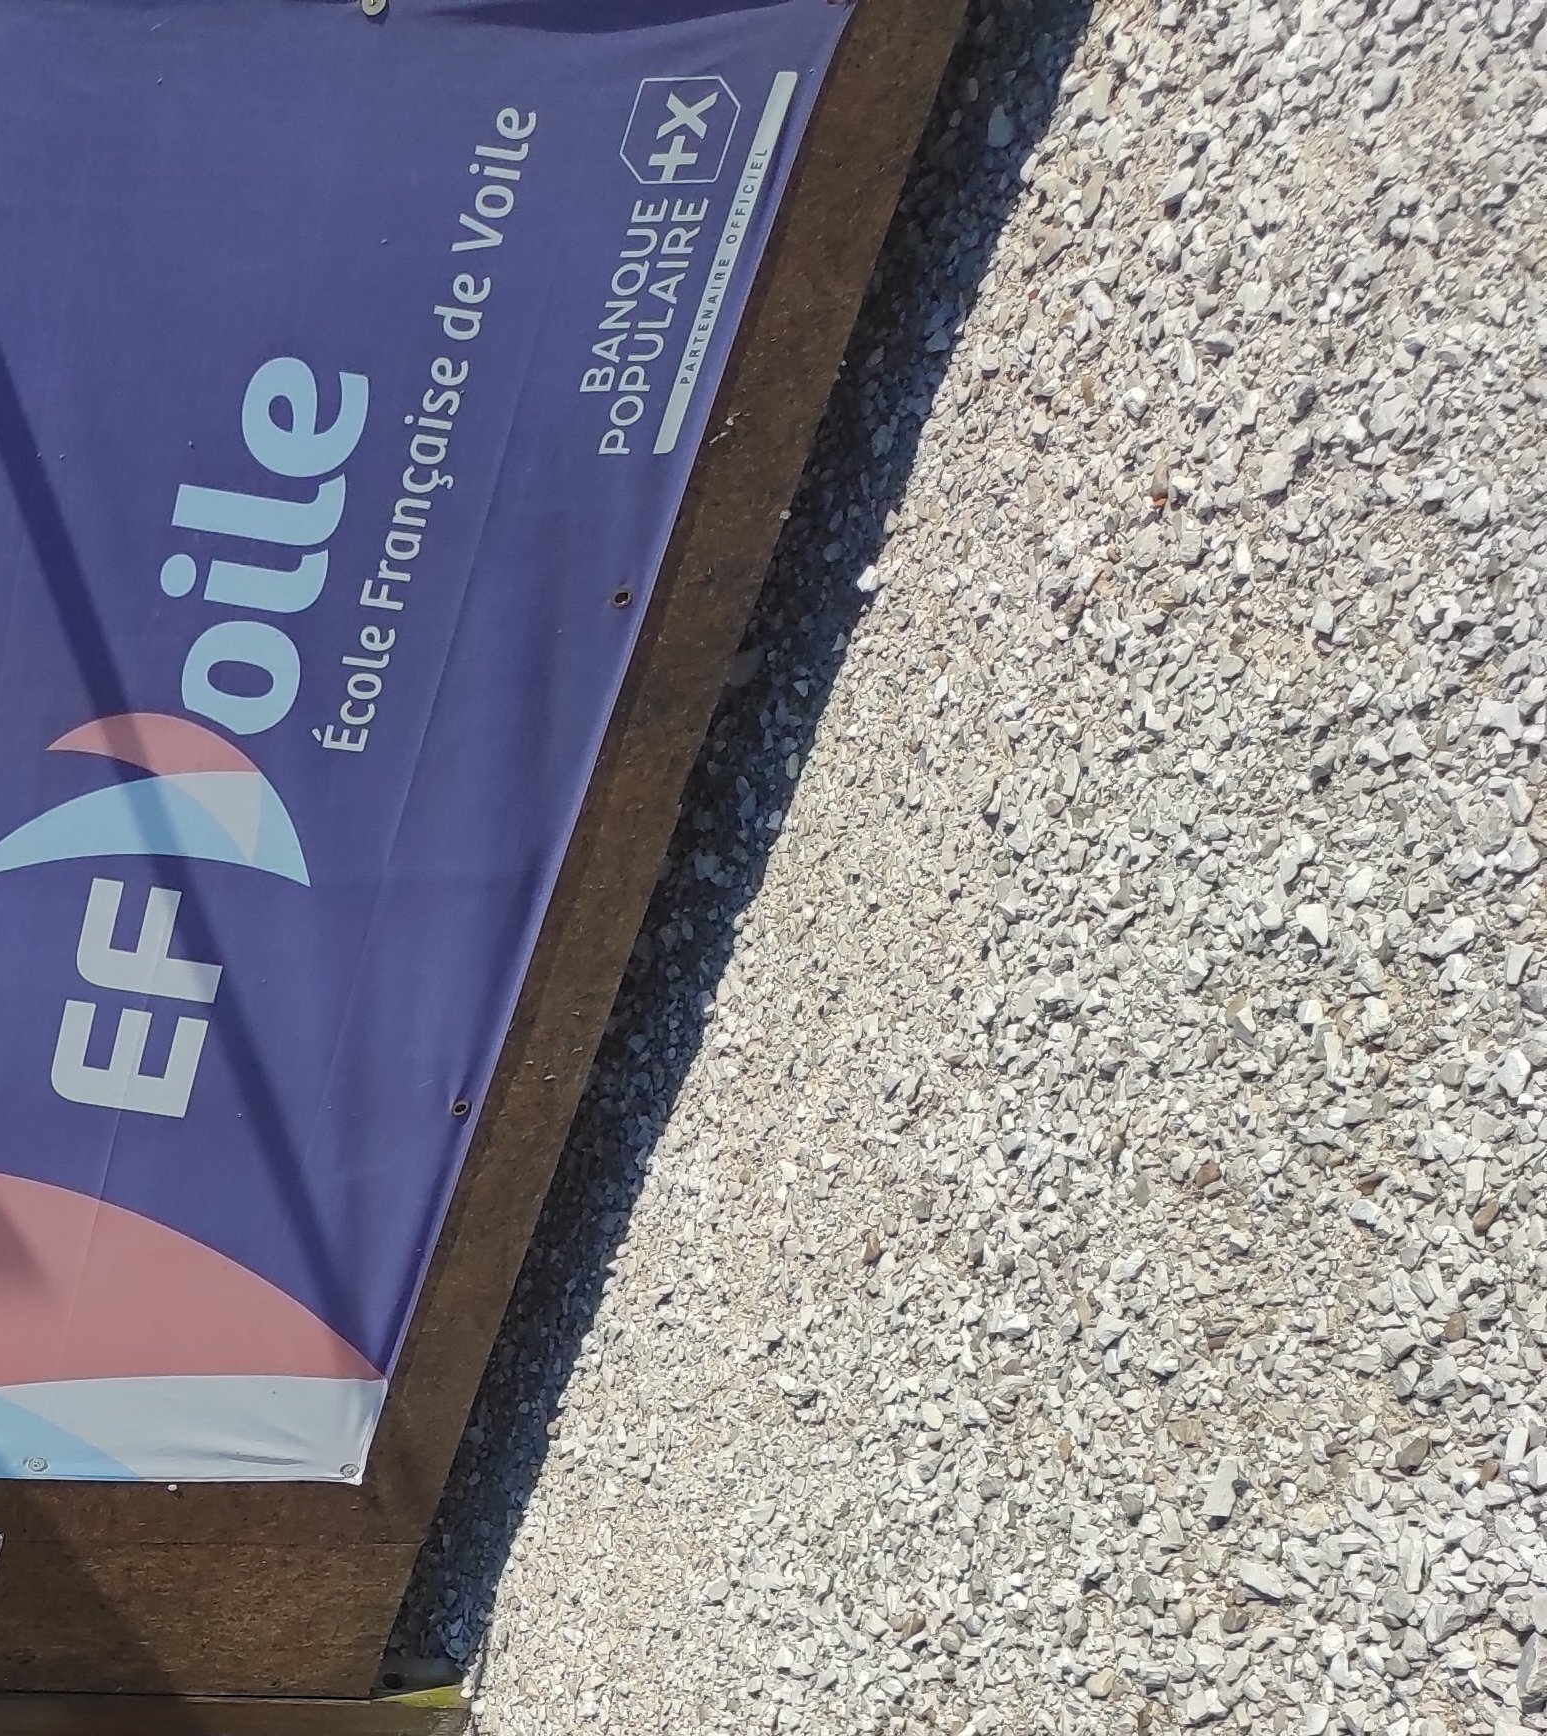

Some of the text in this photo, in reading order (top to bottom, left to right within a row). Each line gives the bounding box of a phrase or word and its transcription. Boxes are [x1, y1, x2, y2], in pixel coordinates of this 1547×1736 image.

[579, 197, 670, 393] BANQUE
[597, 197, 709, 456] POPULAIRE
[678, 147, 769, 386] PARTENAIRE OFFICIEL
[312, 106, 537, 753] École Française de Voile
